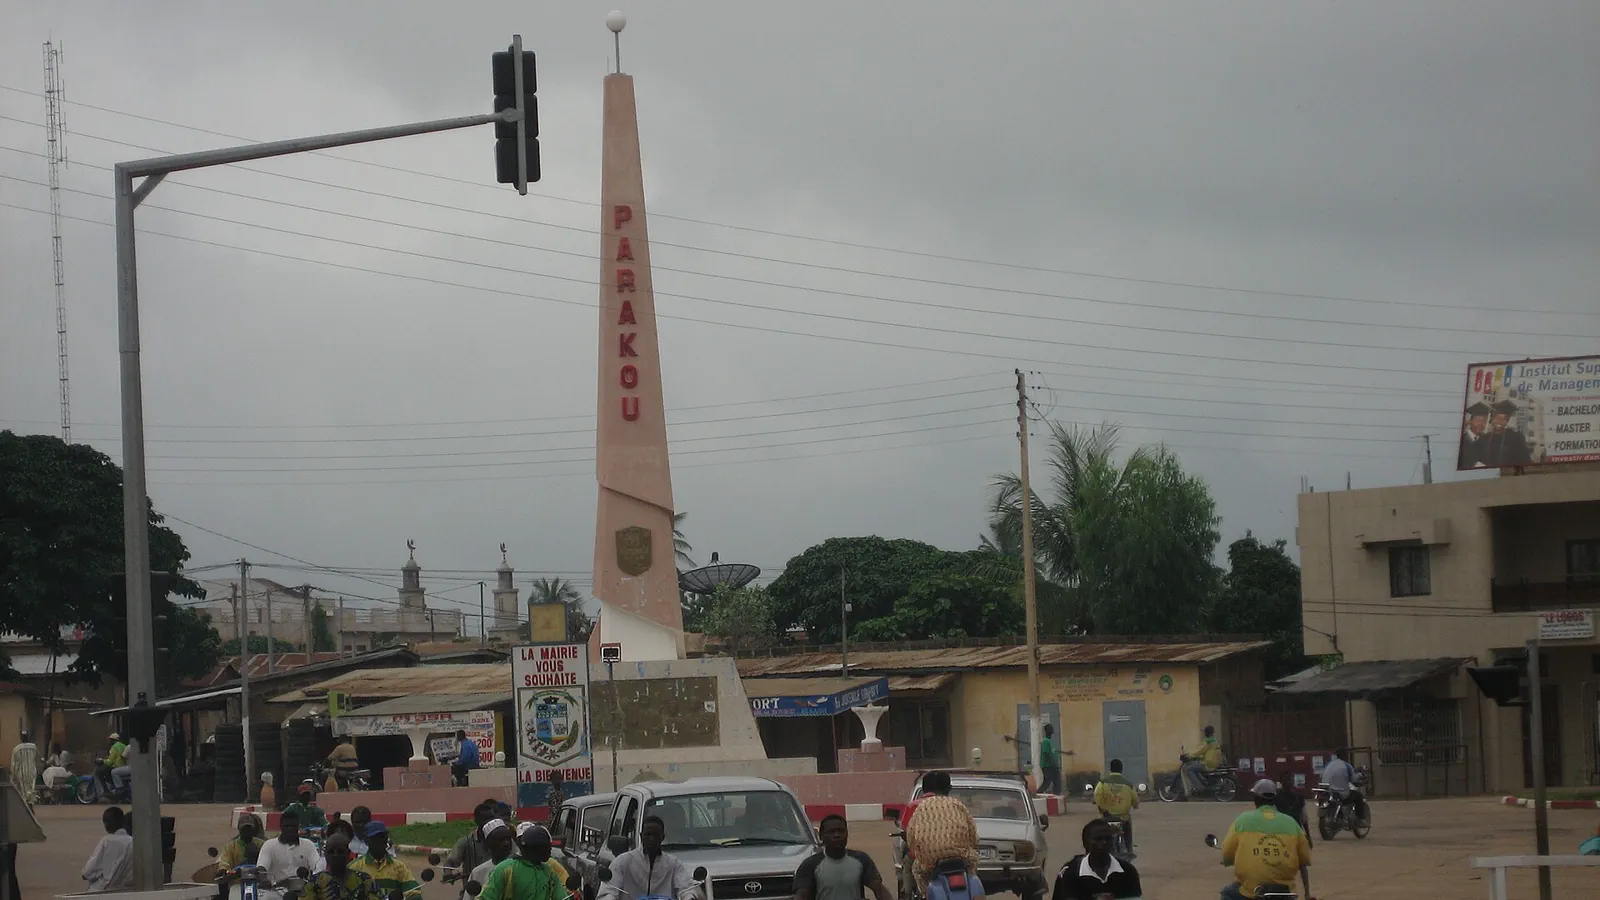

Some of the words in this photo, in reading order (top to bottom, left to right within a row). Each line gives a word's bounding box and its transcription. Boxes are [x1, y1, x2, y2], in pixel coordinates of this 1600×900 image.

[614, 205, 640, 421] PARAKOU
[1519, 363, 1572, 378] Institut
[1556, 423, 1591, 434] MASTER
[521, 648, 535, 661] LA
[540, 646, 578, 660] MAIRIE
[535, 660, 564, 673] VOUS
[524, 672, 577, 687] SOUHAITE
[519, 770, 532, 782] LA
[535, 768, 591, 782] BIEVENUE
